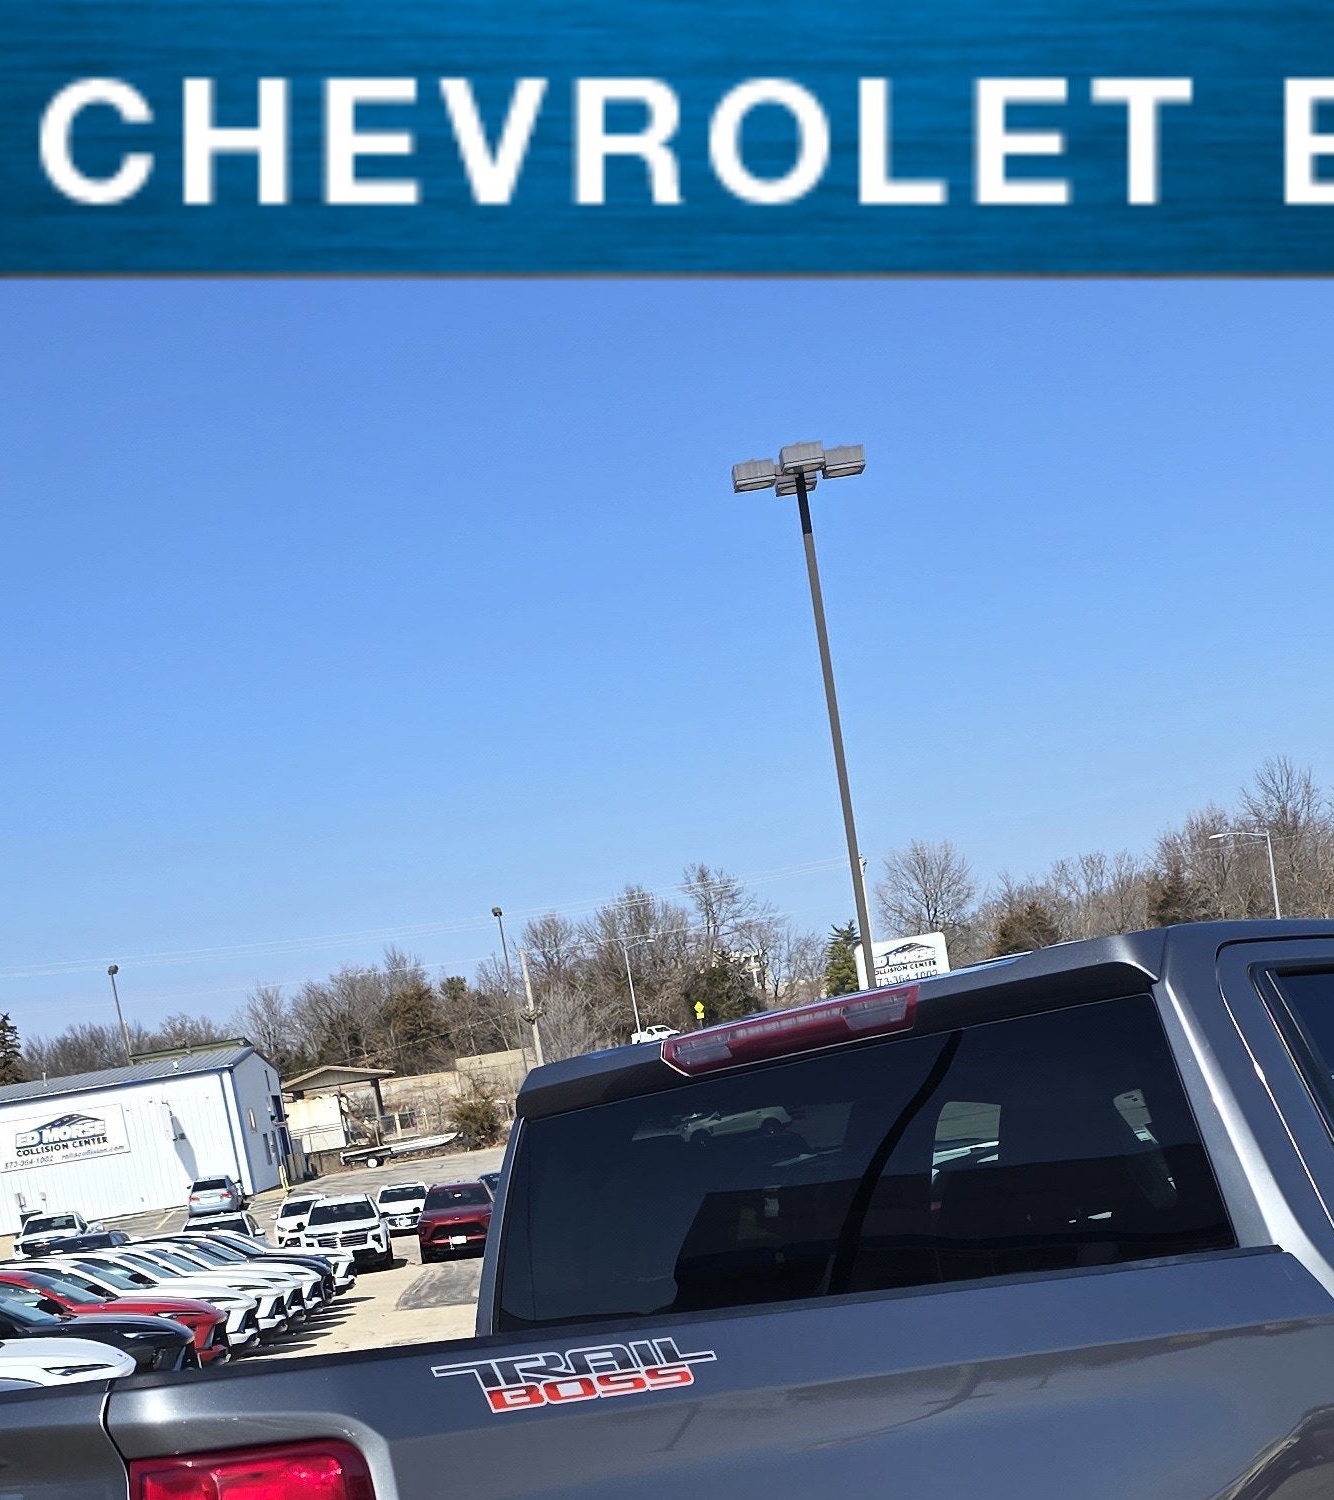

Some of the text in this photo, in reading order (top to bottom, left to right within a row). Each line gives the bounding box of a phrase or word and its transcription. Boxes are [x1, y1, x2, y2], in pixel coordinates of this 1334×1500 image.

[875, 959, 937, 975] OLLISION CENTER
[16, 1119, 106, 1149] ED MORSE
[16, 1136, 109, 1158] COLLISION CENTER
[431, 1337, 717, 1390] TRAIL
[484, 1362, 695, 1413] BOSS
